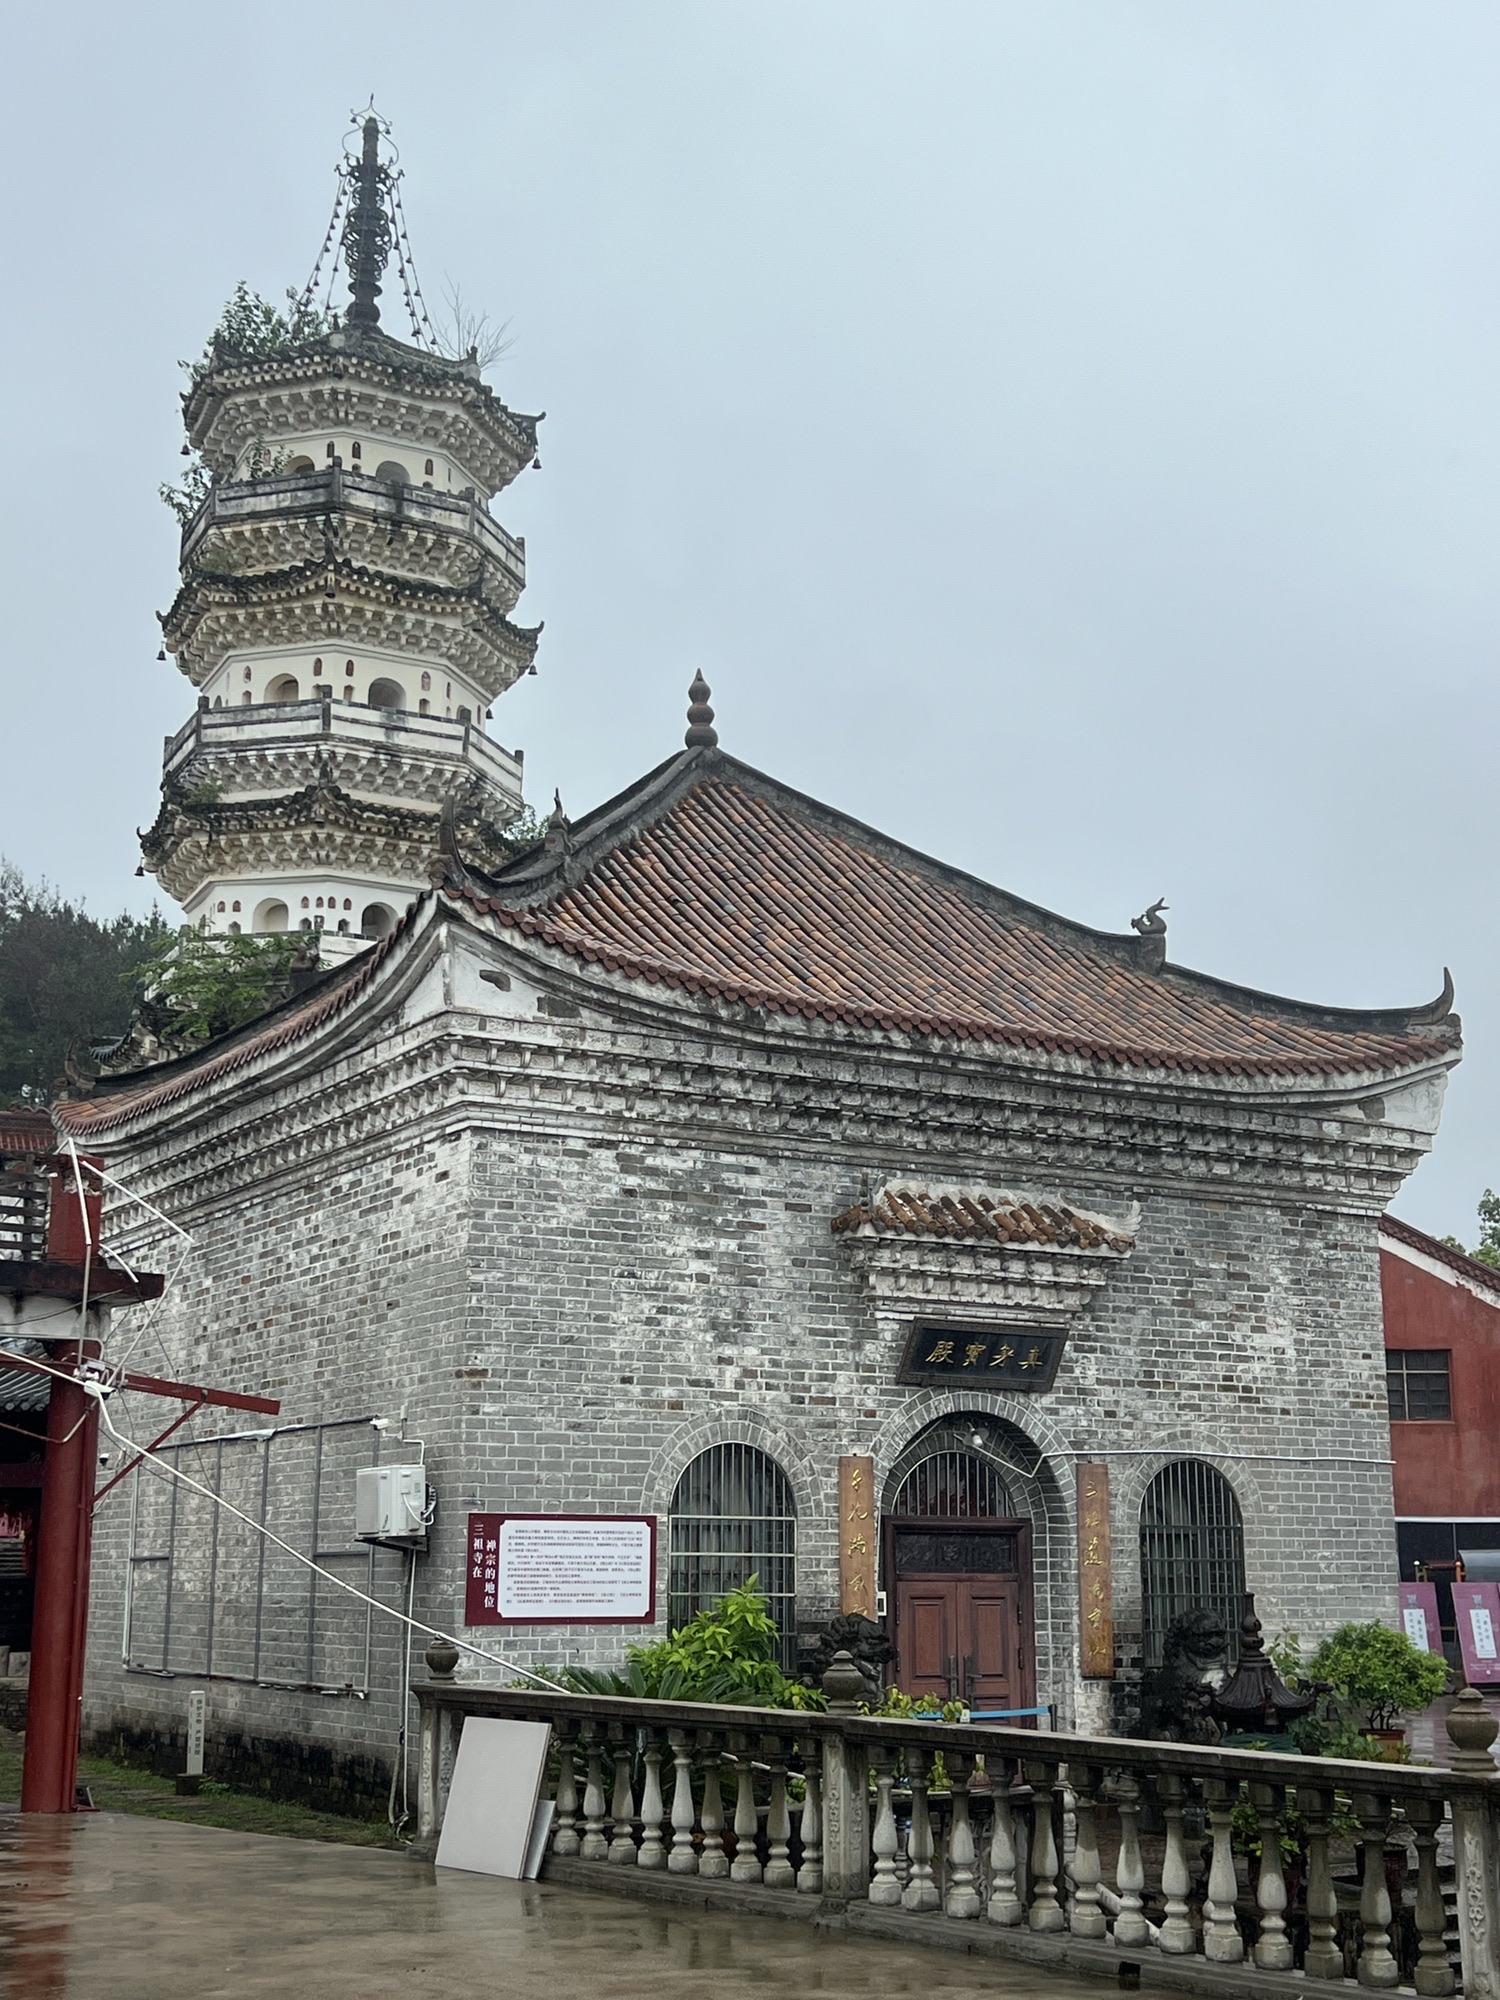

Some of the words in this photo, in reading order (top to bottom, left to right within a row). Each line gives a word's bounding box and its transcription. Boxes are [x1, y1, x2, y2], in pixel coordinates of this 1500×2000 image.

[472, 1524, 484, 1578] 三祖寺在
[484, 1539, 497, 1608] 禅宗的地位
